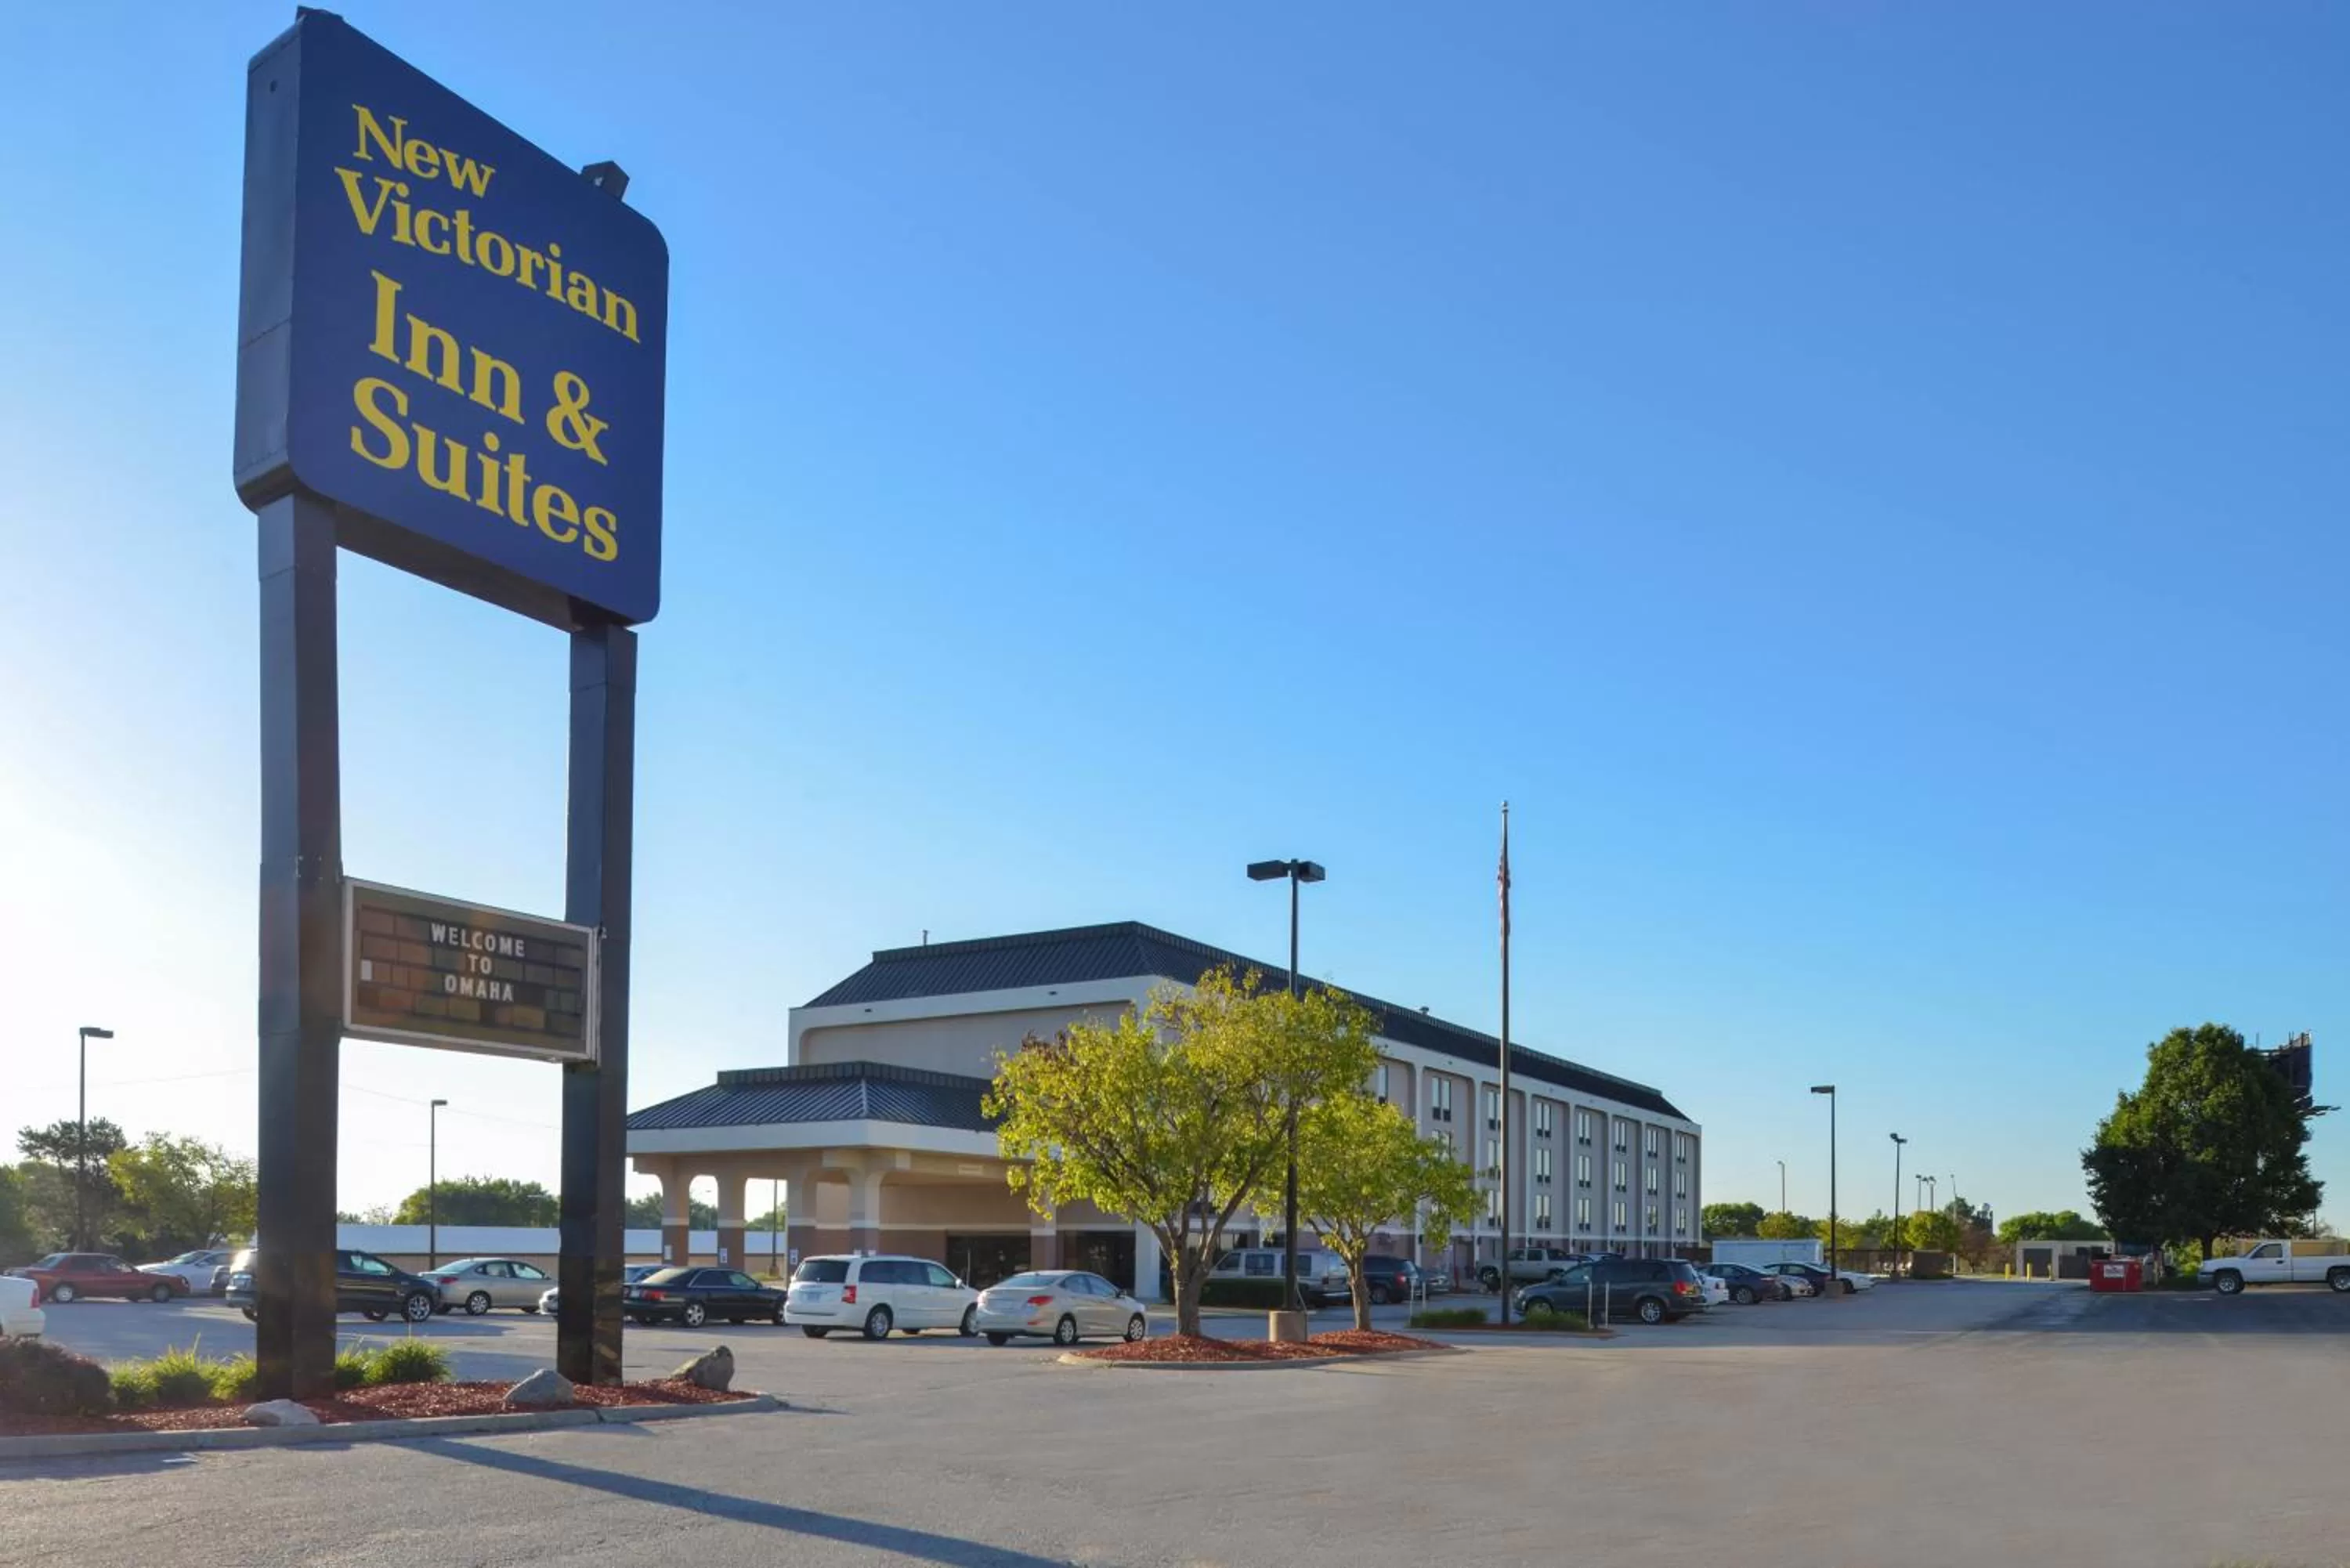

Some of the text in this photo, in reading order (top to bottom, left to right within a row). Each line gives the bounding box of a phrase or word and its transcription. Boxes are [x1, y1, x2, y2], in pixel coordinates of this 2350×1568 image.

[352, 103, 496, 198] New
[334, 167, 641, 344] Victorian
[368, 270, 609, 465] Inn &
[350, 378, 619, 562] Suites
[431, 923, 525, 957] WELCOME
[468, 954, 492, 974] TO
[444, 975, 513, 1003] OMAHA
